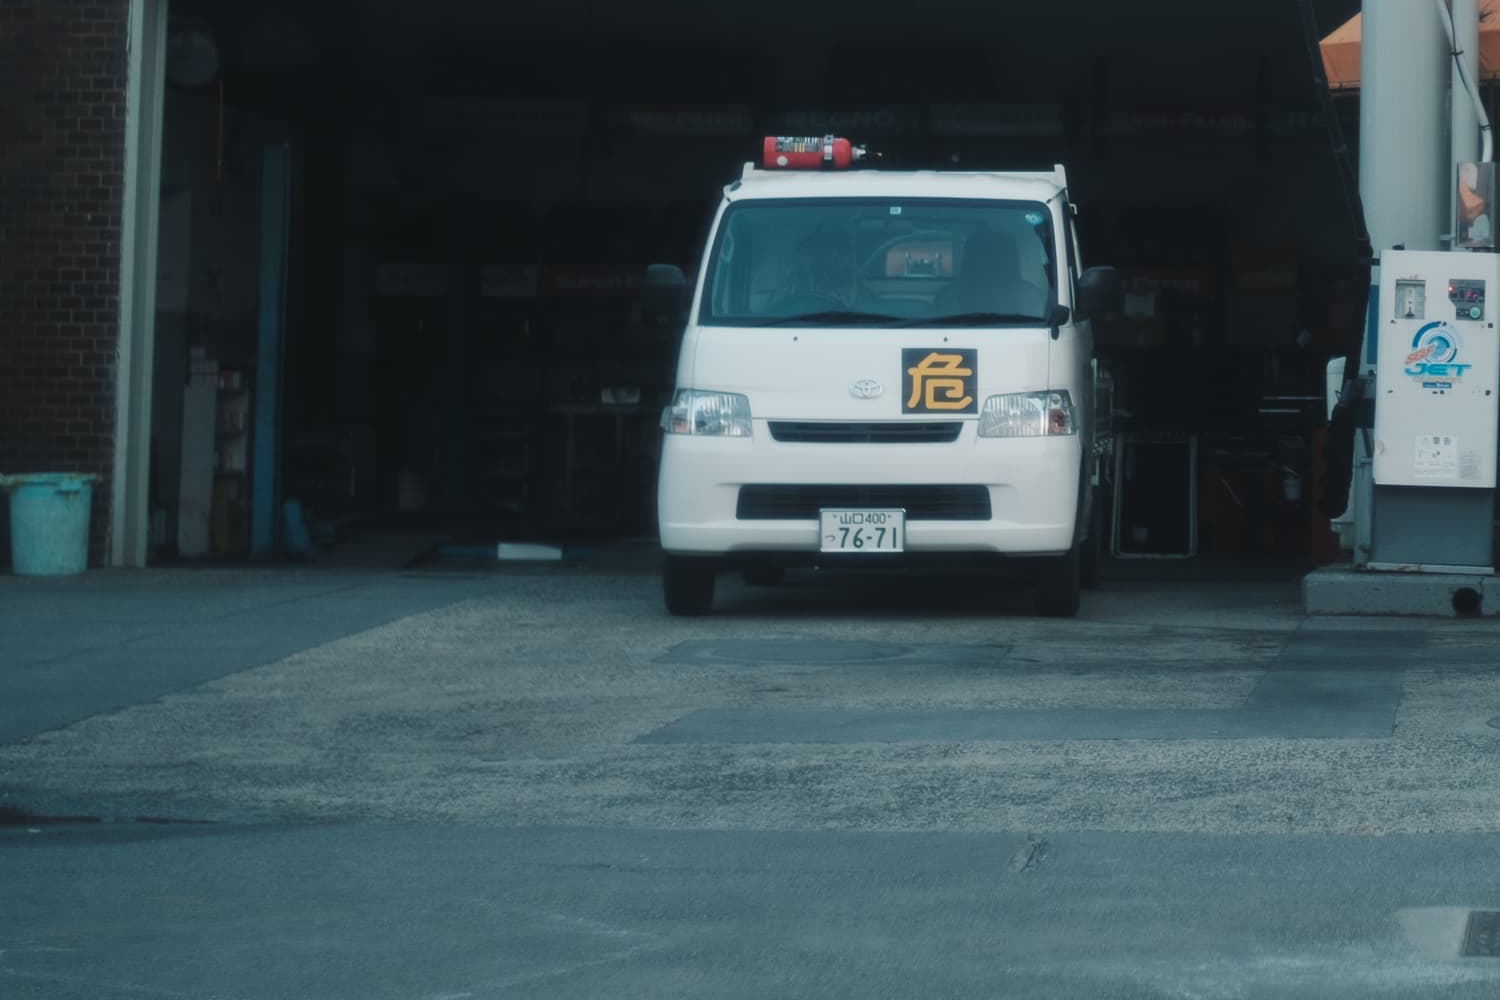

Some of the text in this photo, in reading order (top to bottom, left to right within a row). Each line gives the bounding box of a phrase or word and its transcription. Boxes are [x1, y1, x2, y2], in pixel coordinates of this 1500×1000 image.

[1403, 362, 1473, 377] JET
[907, 352, 974, 410] 危
[838, 527, 897, 549] 76-71
